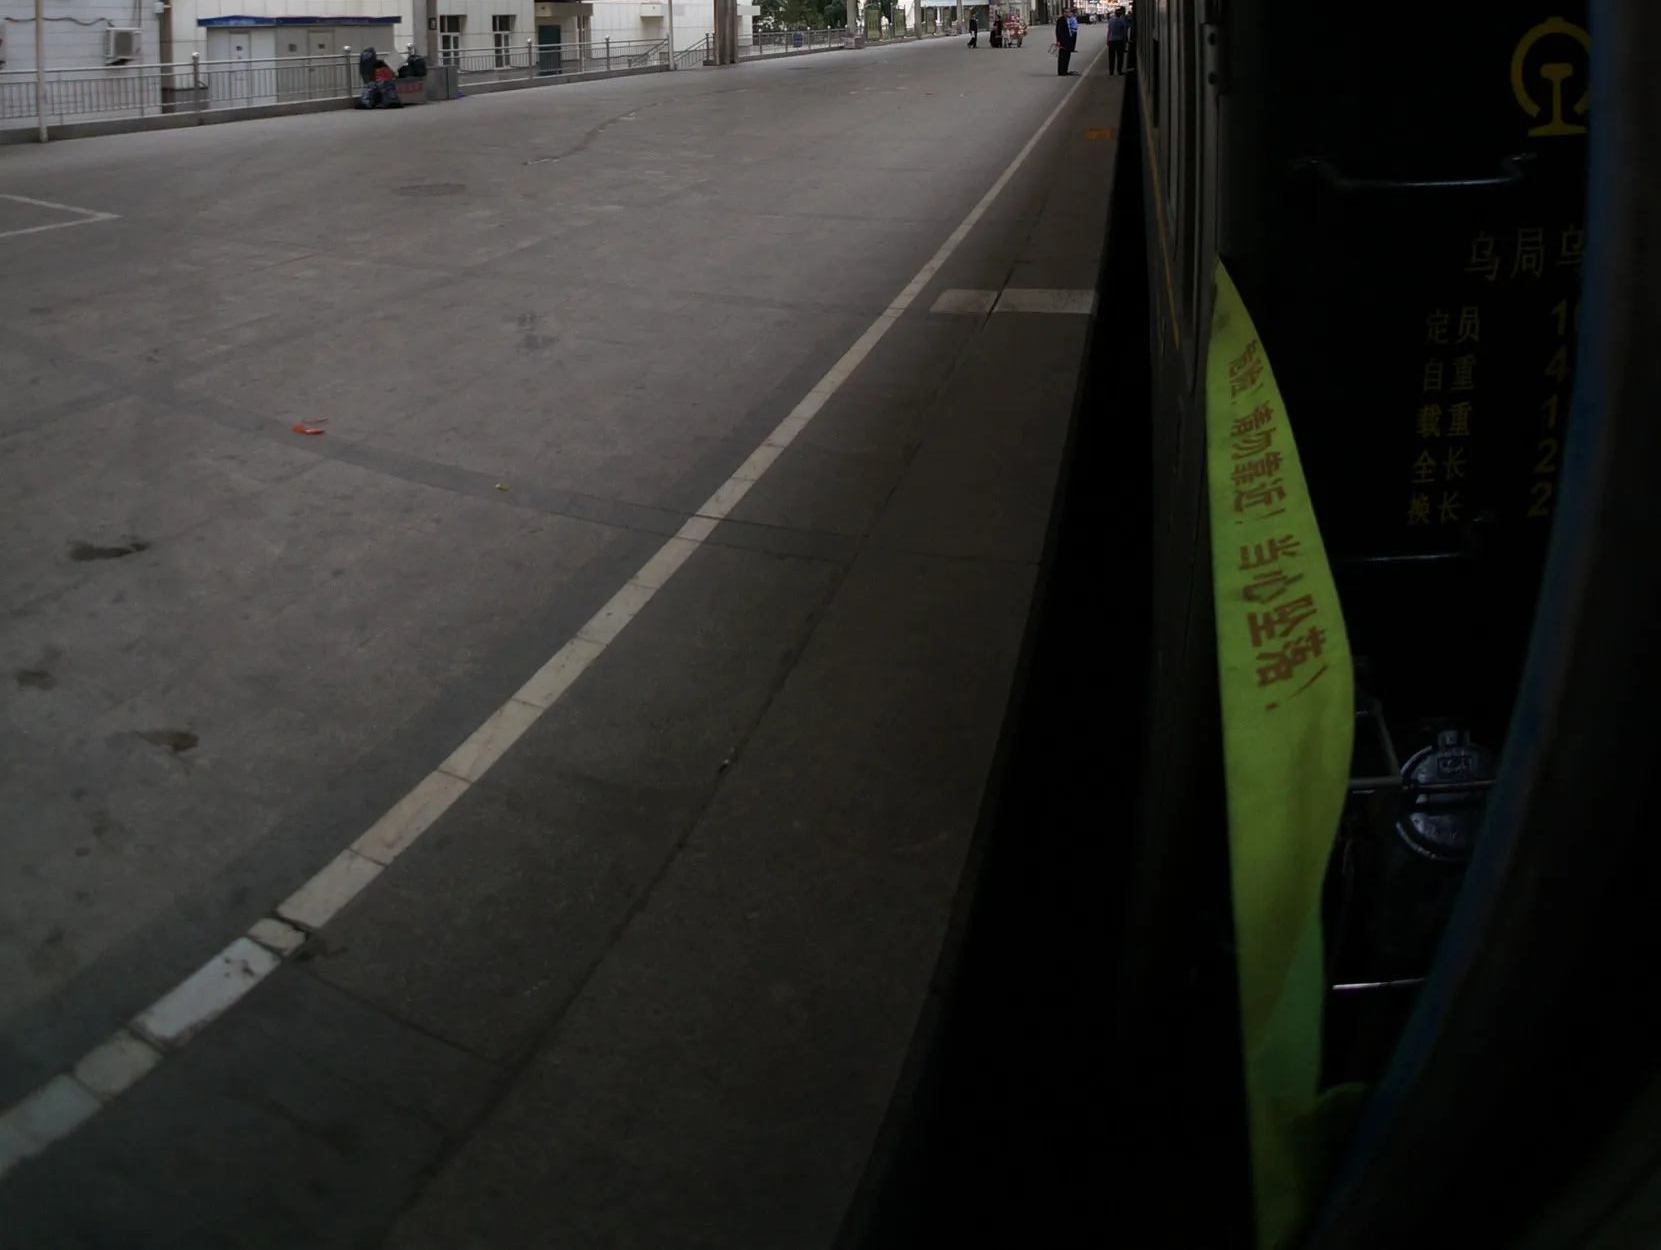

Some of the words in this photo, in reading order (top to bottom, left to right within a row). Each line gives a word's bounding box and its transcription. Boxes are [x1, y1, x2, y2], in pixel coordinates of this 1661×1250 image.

[1425, 303, 1481, 346] 定员
[1422, 351, 1476, 395] 自重
[1415, 400, 1473, 440] 载重
[1410, 446, 1468, 486] 全长
[1406, 490, 1461, 527] 换长
